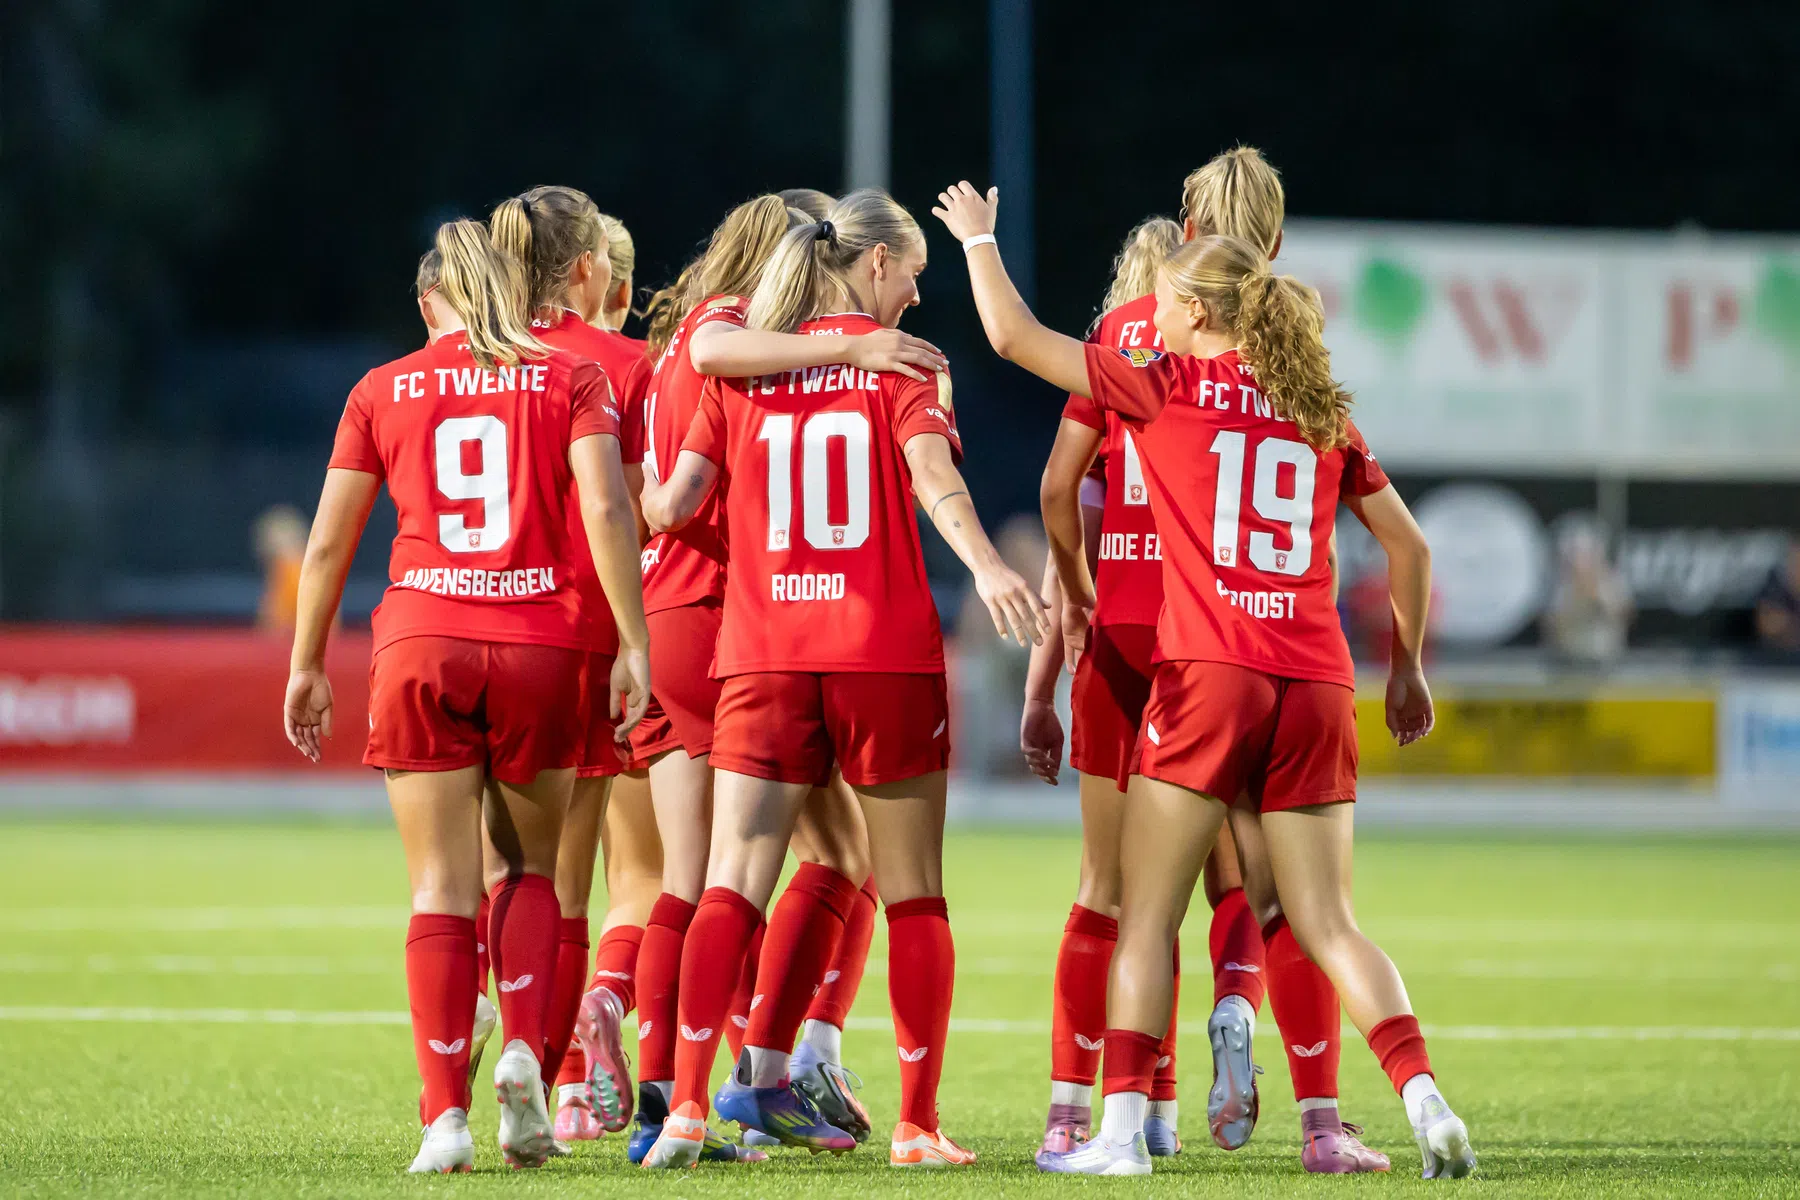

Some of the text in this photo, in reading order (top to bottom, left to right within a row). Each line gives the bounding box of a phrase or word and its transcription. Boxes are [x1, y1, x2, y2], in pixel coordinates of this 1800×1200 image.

[1118, 320, 1148, 348] FC
[393, 364, 549, 402] FC TWENTE
[786, 363, 880, 395] TWENTE
[1198, 379, 1231, 410] FC
[434, 415, 510, 553] 9
[758, 411, 870, 550] 10
[1208, 430, 1317, 577] 19
[1098, 533, 1138, 560] UDE
[771, 572, 846, 602] ROORD
